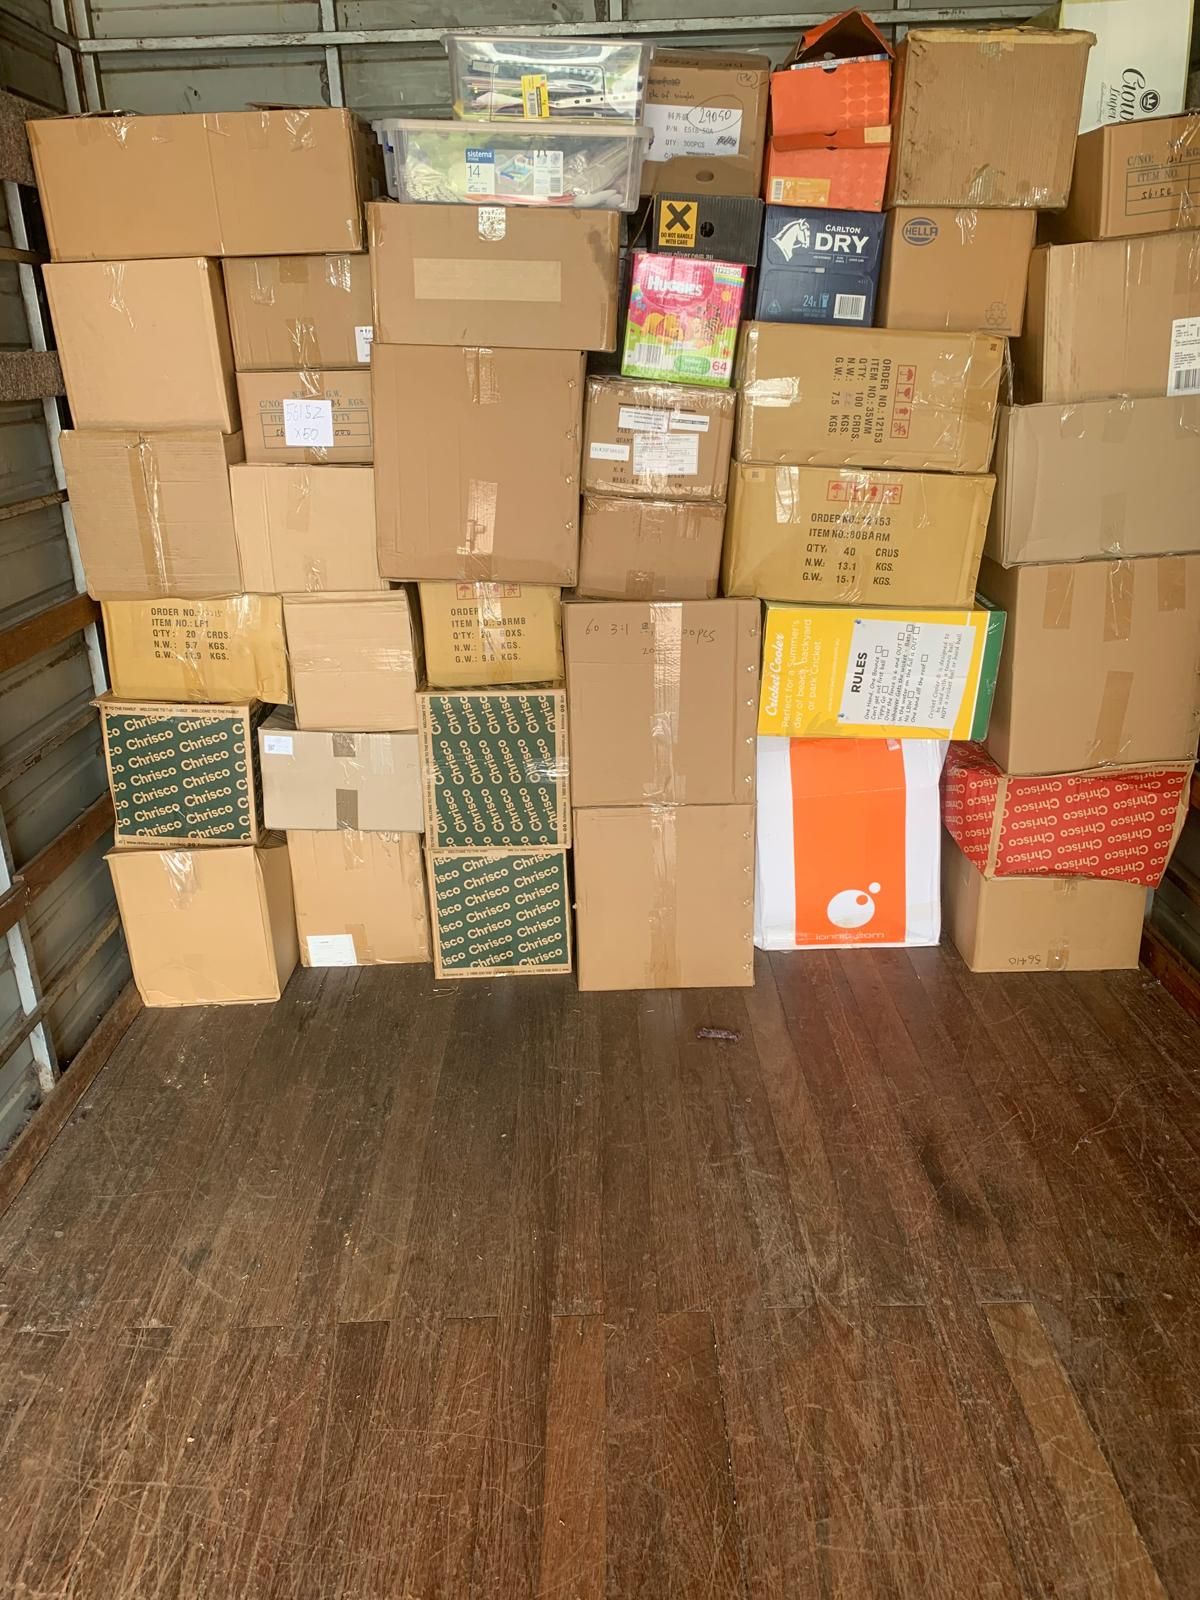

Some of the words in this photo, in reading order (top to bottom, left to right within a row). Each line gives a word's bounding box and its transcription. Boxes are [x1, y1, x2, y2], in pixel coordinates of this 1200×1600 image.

[467, 165, 480, 178] 14
[825, 224, 861, 234] CARLTON
[905, 226, 938, 236] HELLA
[814, 232, 870, 254] DRY
[712, 361, 727, 372] 64
[870, 359, 879, 380] ITEM
[880, 359, 891, 390] ORDER
[831, 392, 840, 405] 7.5
[855, 392, 863, 407] 100
[840, 415, 849, 436] KGS.
[811, 513, 840, 523] ORDER
[808, 529, 829, 538] ITEM
[843, 547, 856, 556] 40
[838, 561, 856, 571] 13.1
[875, 562, 894, 571] KGS.
[836, 575, 855, 584] 15.1
[873, 576, 891, 585] KGS.
[151, 608, 179, 616] ORDER
[451, 608, 479, 616] ORDER
[152, 619, 171, 627] ITEM
[799, 619, 812, 663] backyard
[769, 632, 784, 672] Cooler
[809, 641, 822, 675] Cricket
[851, 652, 867, 693] RULES
[765, 673, 780, 716] Cricket
[785, 679, 793, 691] for
[808, 677, 816, 698] park
[781, 694, 793, 728] Perfect
[795, 700, 802, 709] of
[808, 701, 815, 711] or
[793, 712, 803, 728] day
[126, 730, 173, 750] Chrisco
[180, 732, 228, 752] Chrisco
[128, 749, 175, 768] Chrisco
[181, 750, 229, 771] Chrisco
[440, 740, 464, 785] Chrisco
[459, 740, 483, 784] Chrisco
[479, 740, 502, 784] Chrisco
[498, 740, 522, 783] Chrisco
[518, 739, 541, 783] Chrisco
[131, 767, 177, 786] Chrisco
[183, 768, 230, 789] Chrisco
[133, 785, 178, 804] Chrisco
[184, 787, 231, 807] Chrisco
[1016, 781, 1062, 796] Chrisco
[1065, 787, 1110, 804] Chrisco
[443, 789, 467, 832] Chrisco
[462, 789, 485, 832] Chrisco
[481, 789, 504, 832] Chrisco
[500, 788, 523, 831] Chrisco
[520, 788, 542, 831] Chrisco
[1014, 798, 1060, 813] Chrisco
[1113, 793, 1157, 810] Chrisco
[135, 803, 180, 822] Chrisco
[186, 805, 233, 824] Chrisco
[1063, 805, 1108, 820] Chrisco
[1111, 811, 1155, 827] Chrisco
[137, 821, 182, 837] Chrisco
[188, 822, 234, 838] Chrisco
[1011, 816, 1057, 830] Chrisco
[1060, 822, 1105, 837] Chrisco
[1009, 832, 1054, 846] Chrisco
[1108, 828, 1152, 843] Chrisco
[1057, 839, 1102, 854] Chrisco
[1105, 845, 1149, 860] Chrisco
[1006, 849, 1052, 864] Chrisco
[1054, 856, 1099, 870] Chrisco
[514, 866, 558, 888] Chrisco
[1101, 861, 1145, 876] Chrisco
[464, 868, 508, 889] Chrisco
[465, 886, 509, 906] Chrisco
[515, 883, 559, 904] Chrisco
[466, 902, 510, 922] Chrisco
[516, 899, 560, 921] Chrisco
[468, 919, 512, 939] Chrisco
[517, 916, 561, 937] Chrisco
[469, 935, 512, 954] Chrisco
[518, 932, 562, 953] Chrisco
